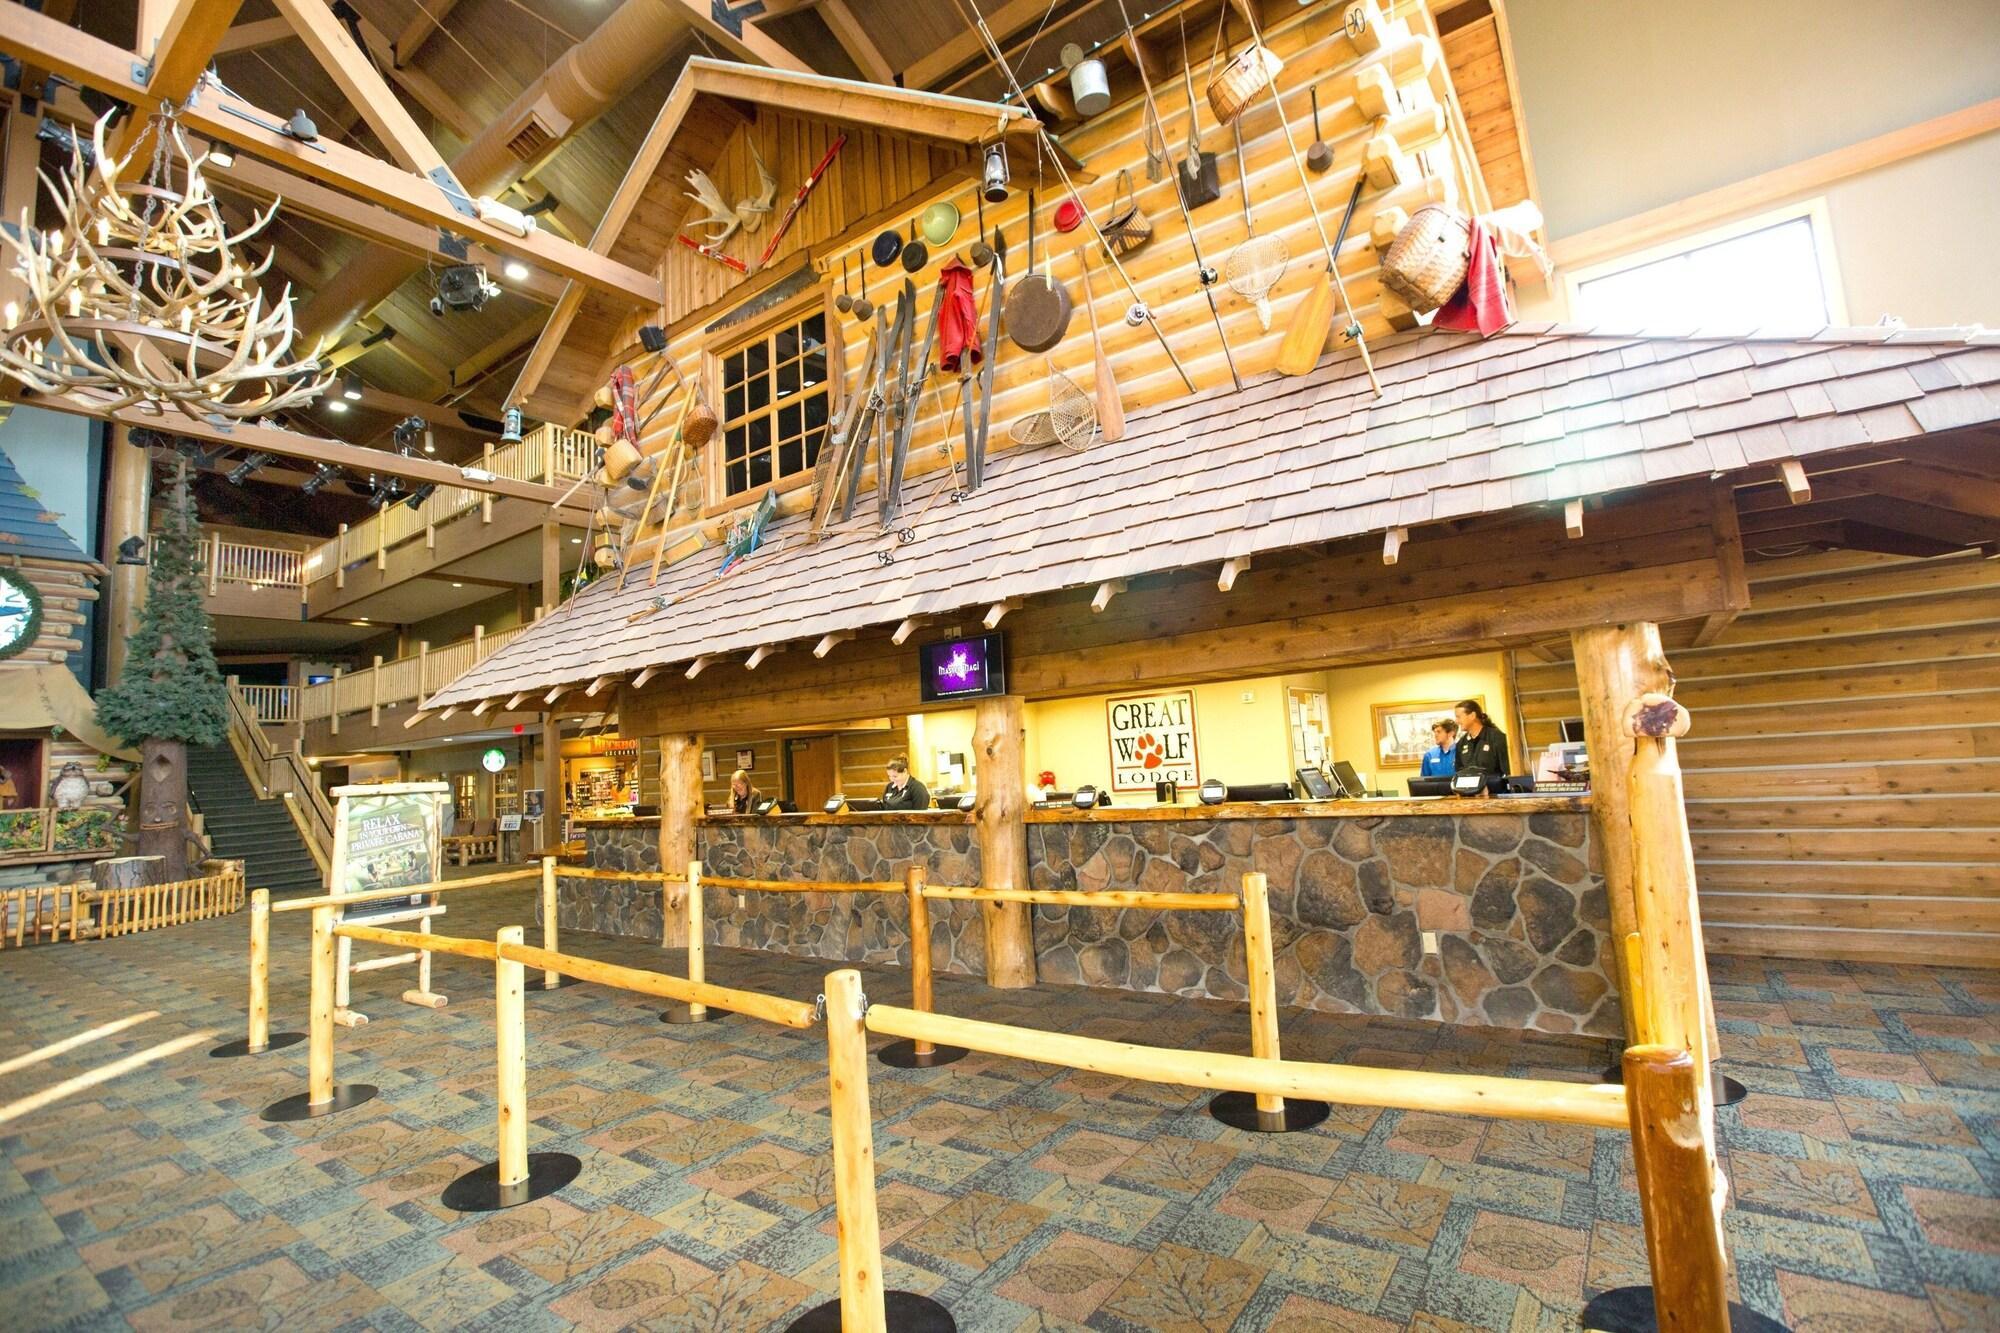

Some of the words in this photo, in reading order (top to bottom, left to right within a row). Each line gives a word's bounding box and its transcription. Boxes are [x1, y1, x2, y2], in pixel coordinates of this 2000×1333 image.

[1112, 698, 1187, 731] GREAT
[1118, 770, 1193, 784] LODGE
[362, 813, 401, 831] RELAX
[351, 837, 385, 851] PRIVATE
